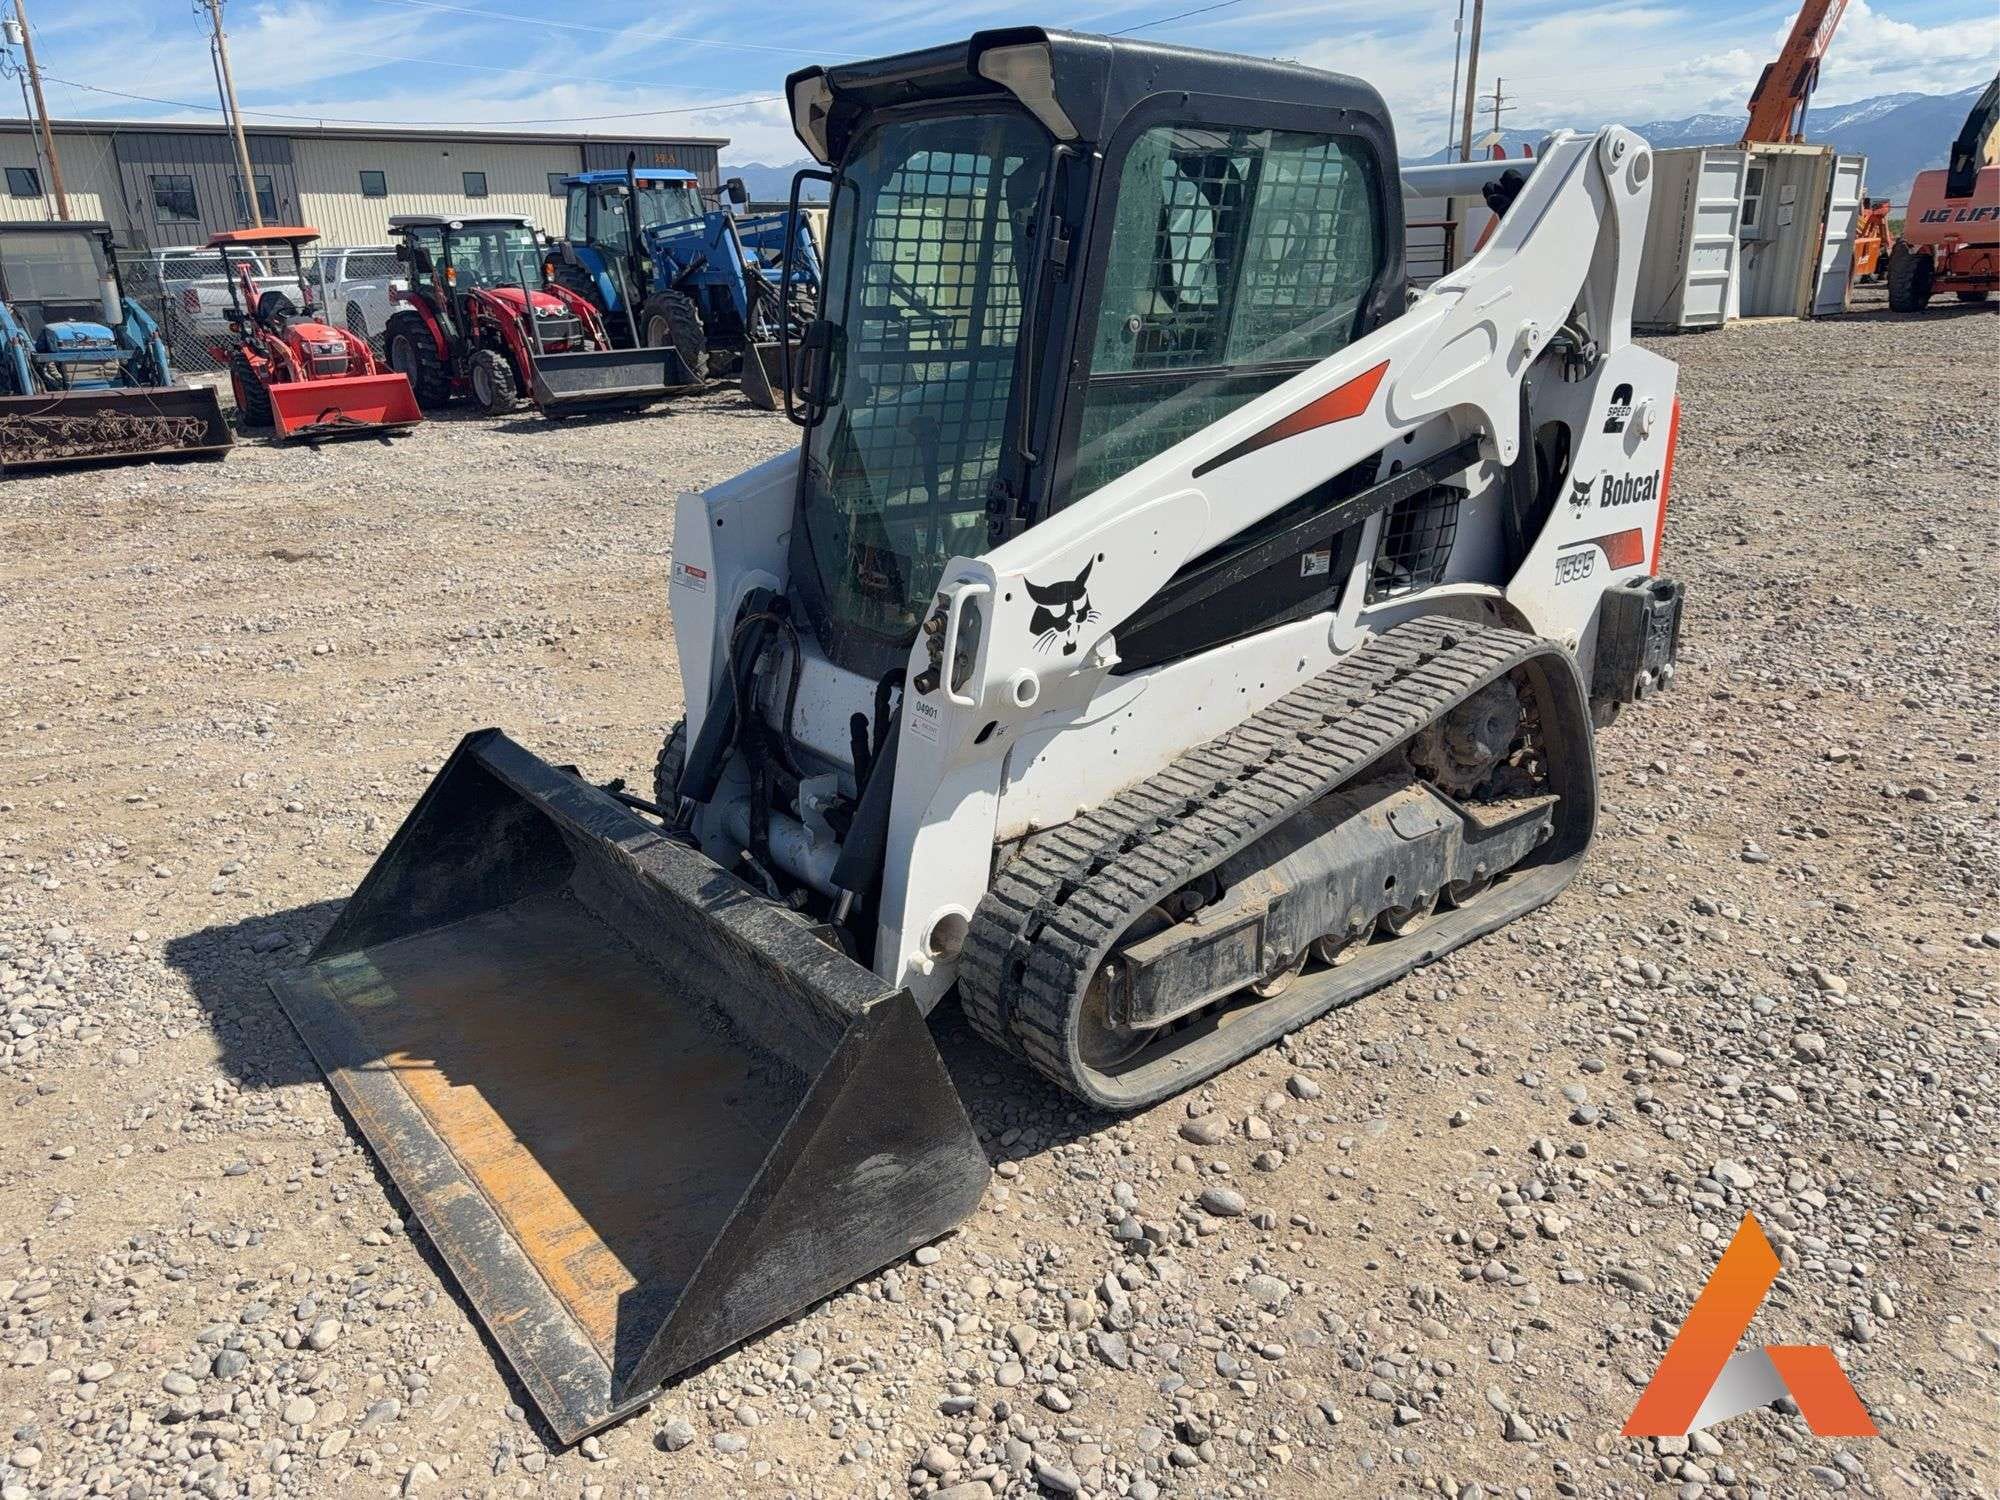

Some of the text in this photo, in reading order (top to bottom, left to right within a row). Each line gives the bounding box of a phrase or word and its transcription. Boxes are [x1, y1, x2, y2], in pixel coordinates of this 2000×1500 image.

[1919, 207, 1952, 224] JLG
[1602, 383, 1633, 434] 2
[1607, 406, 1632, 417] SPEED
[1599, 469, 1660, 508] Bobcat
[1554, 549, 1596, 586] T595
[915, 700, 938, 719] 04901
